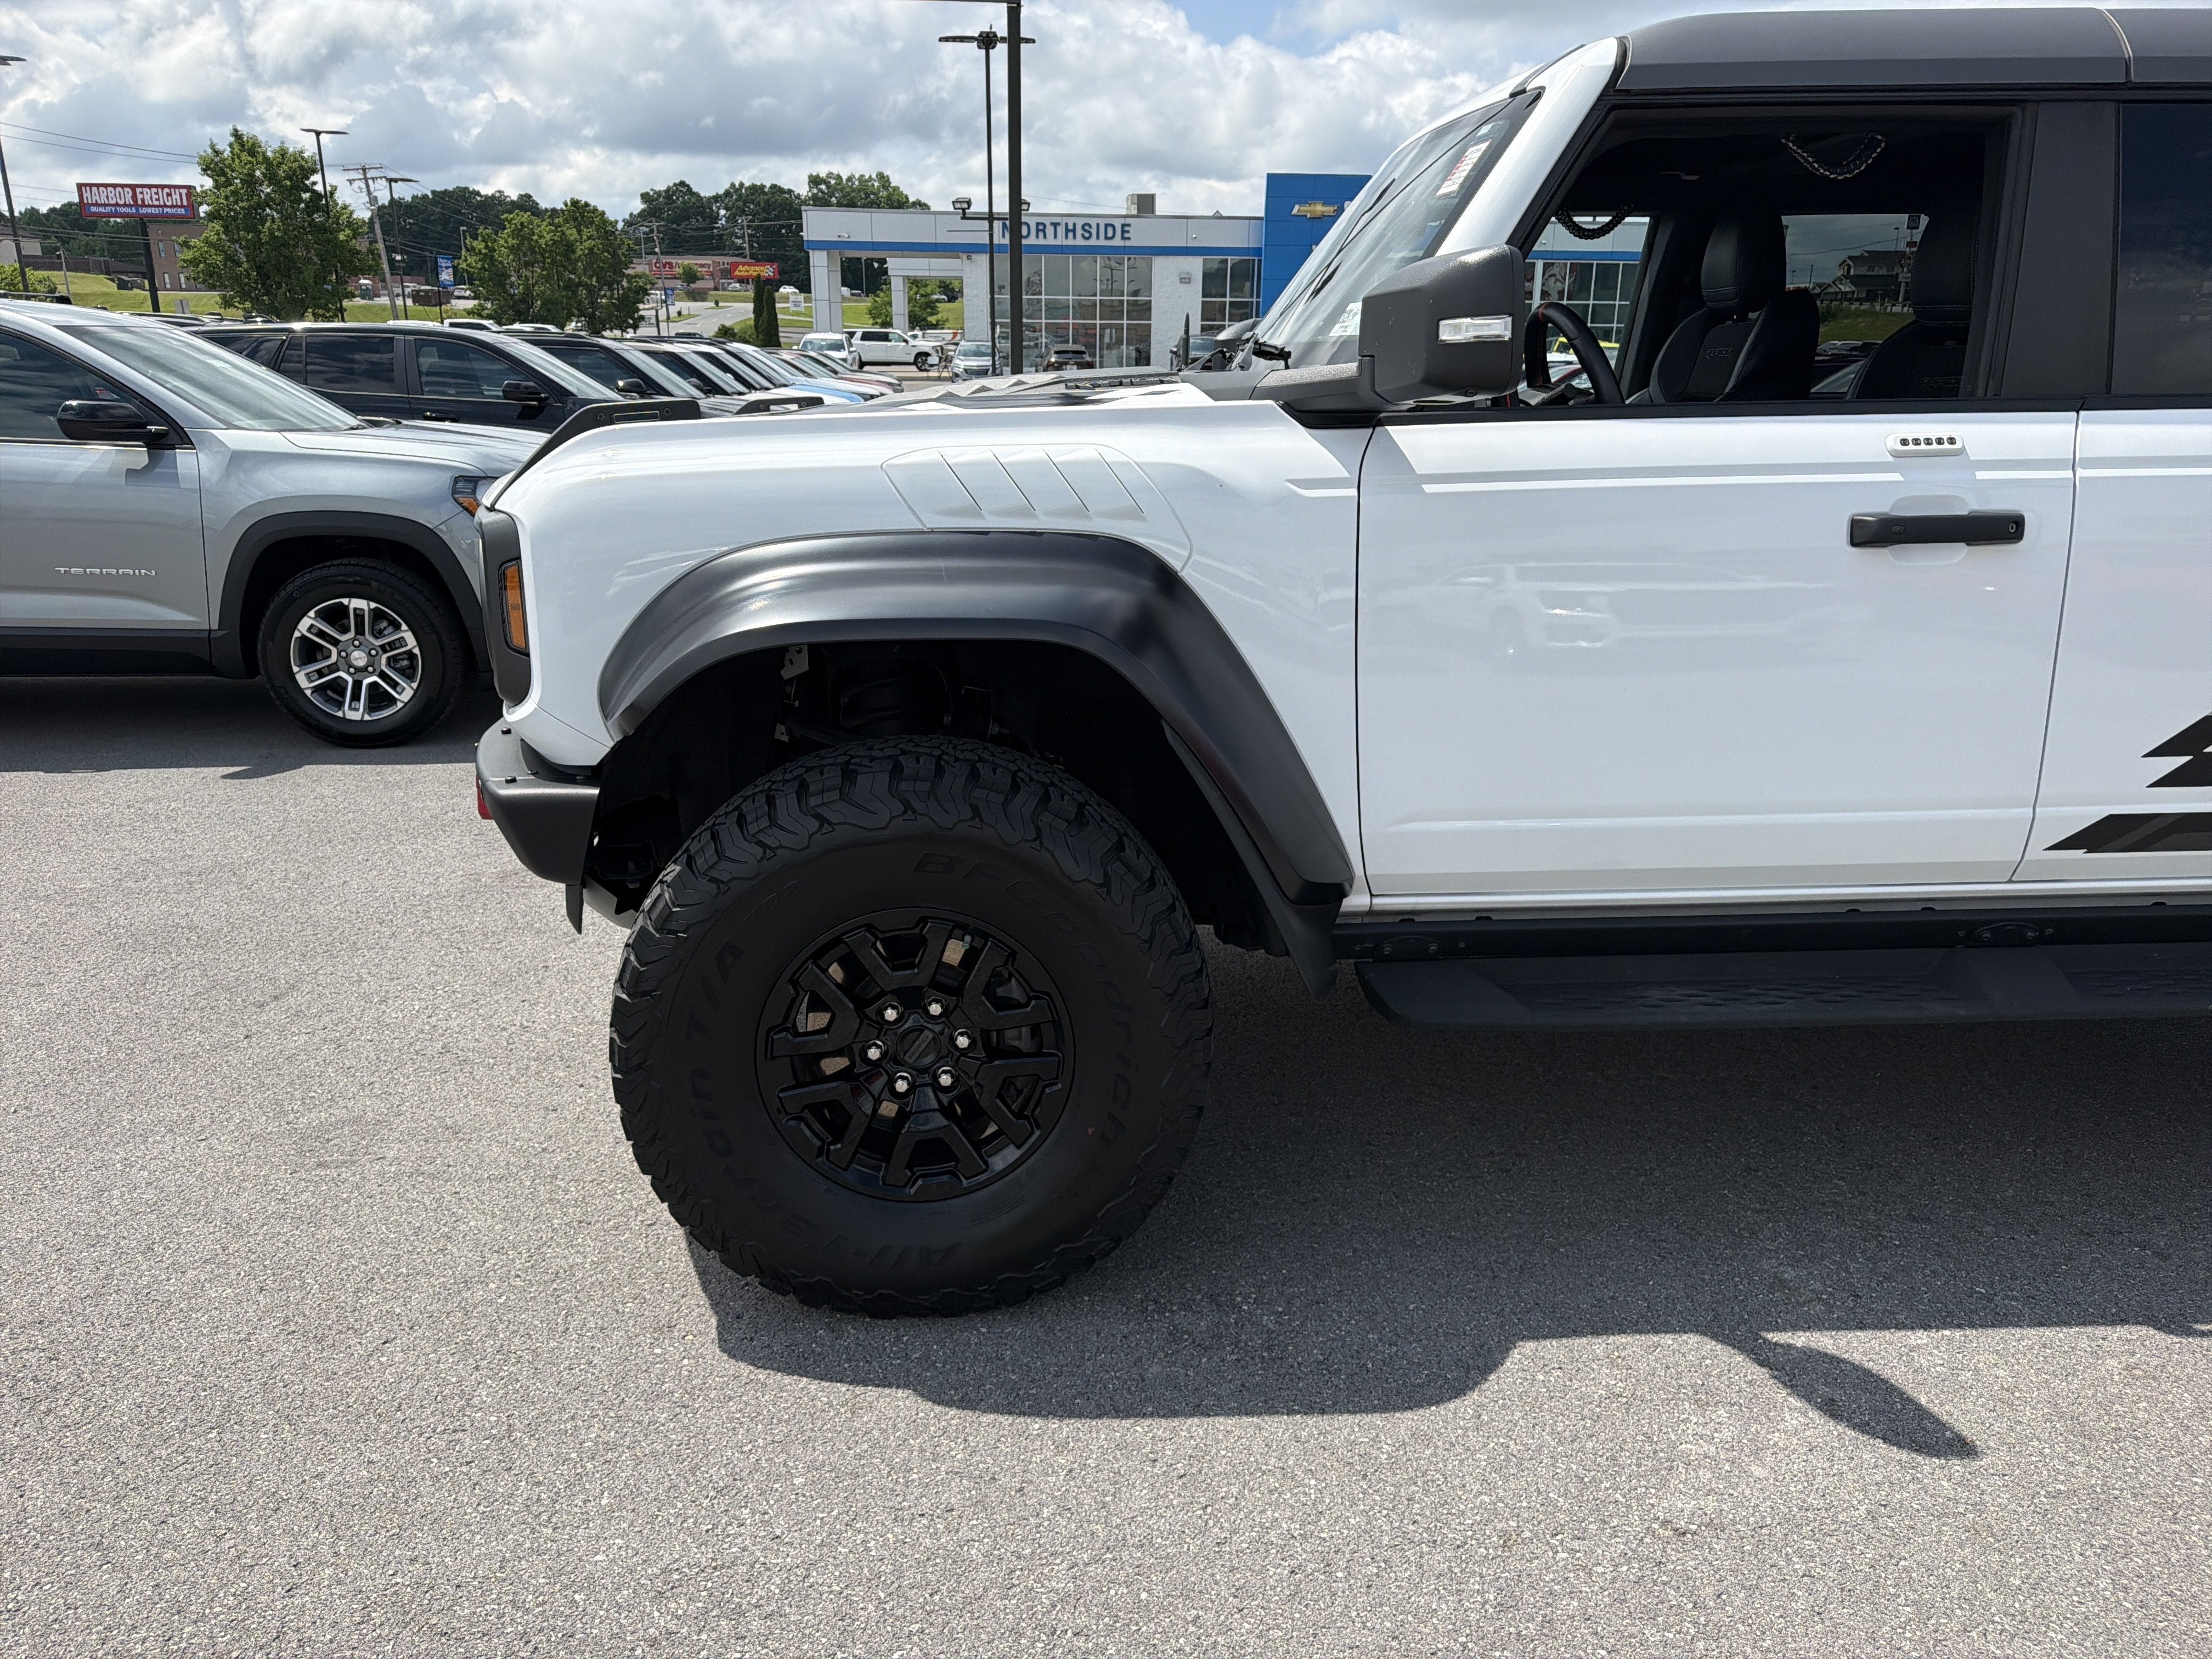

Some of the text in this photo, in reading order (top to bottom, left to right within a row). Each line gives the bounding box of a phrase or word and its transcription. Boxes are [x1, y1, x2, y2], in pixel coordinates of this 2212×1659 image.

[82, 186, 188, 206] HARBOR FREIGHT
[1002, 221, 1131, 240] NORTHSIDE
[54, 567, 157, 576] TERRAIN
[686, 939, 746, 1041] T/A
